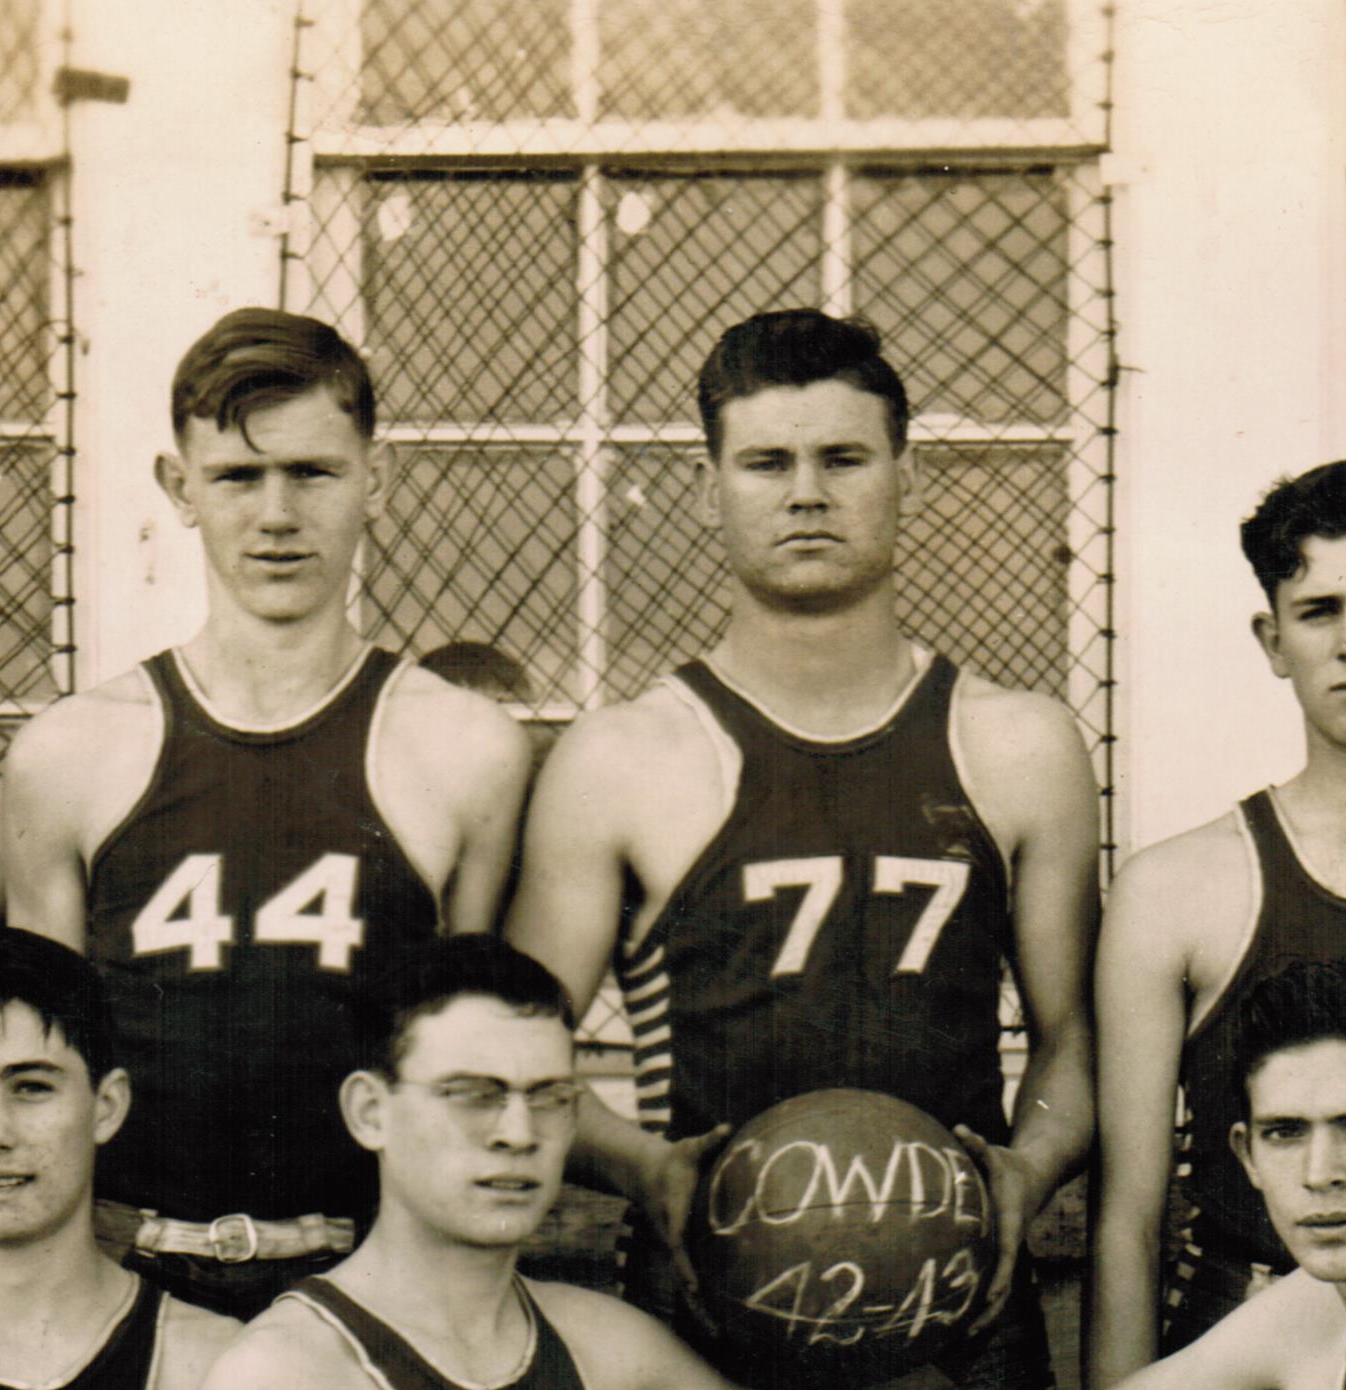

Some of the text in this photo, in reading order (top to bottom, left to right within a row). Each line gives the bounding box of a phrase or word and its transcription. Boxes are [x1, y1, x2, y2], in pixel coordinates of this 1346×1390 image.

[131, 853, 365, 972] 44
[742, 854, 971, 978] 77
[745, 1249, 979, 1345] 42-43
